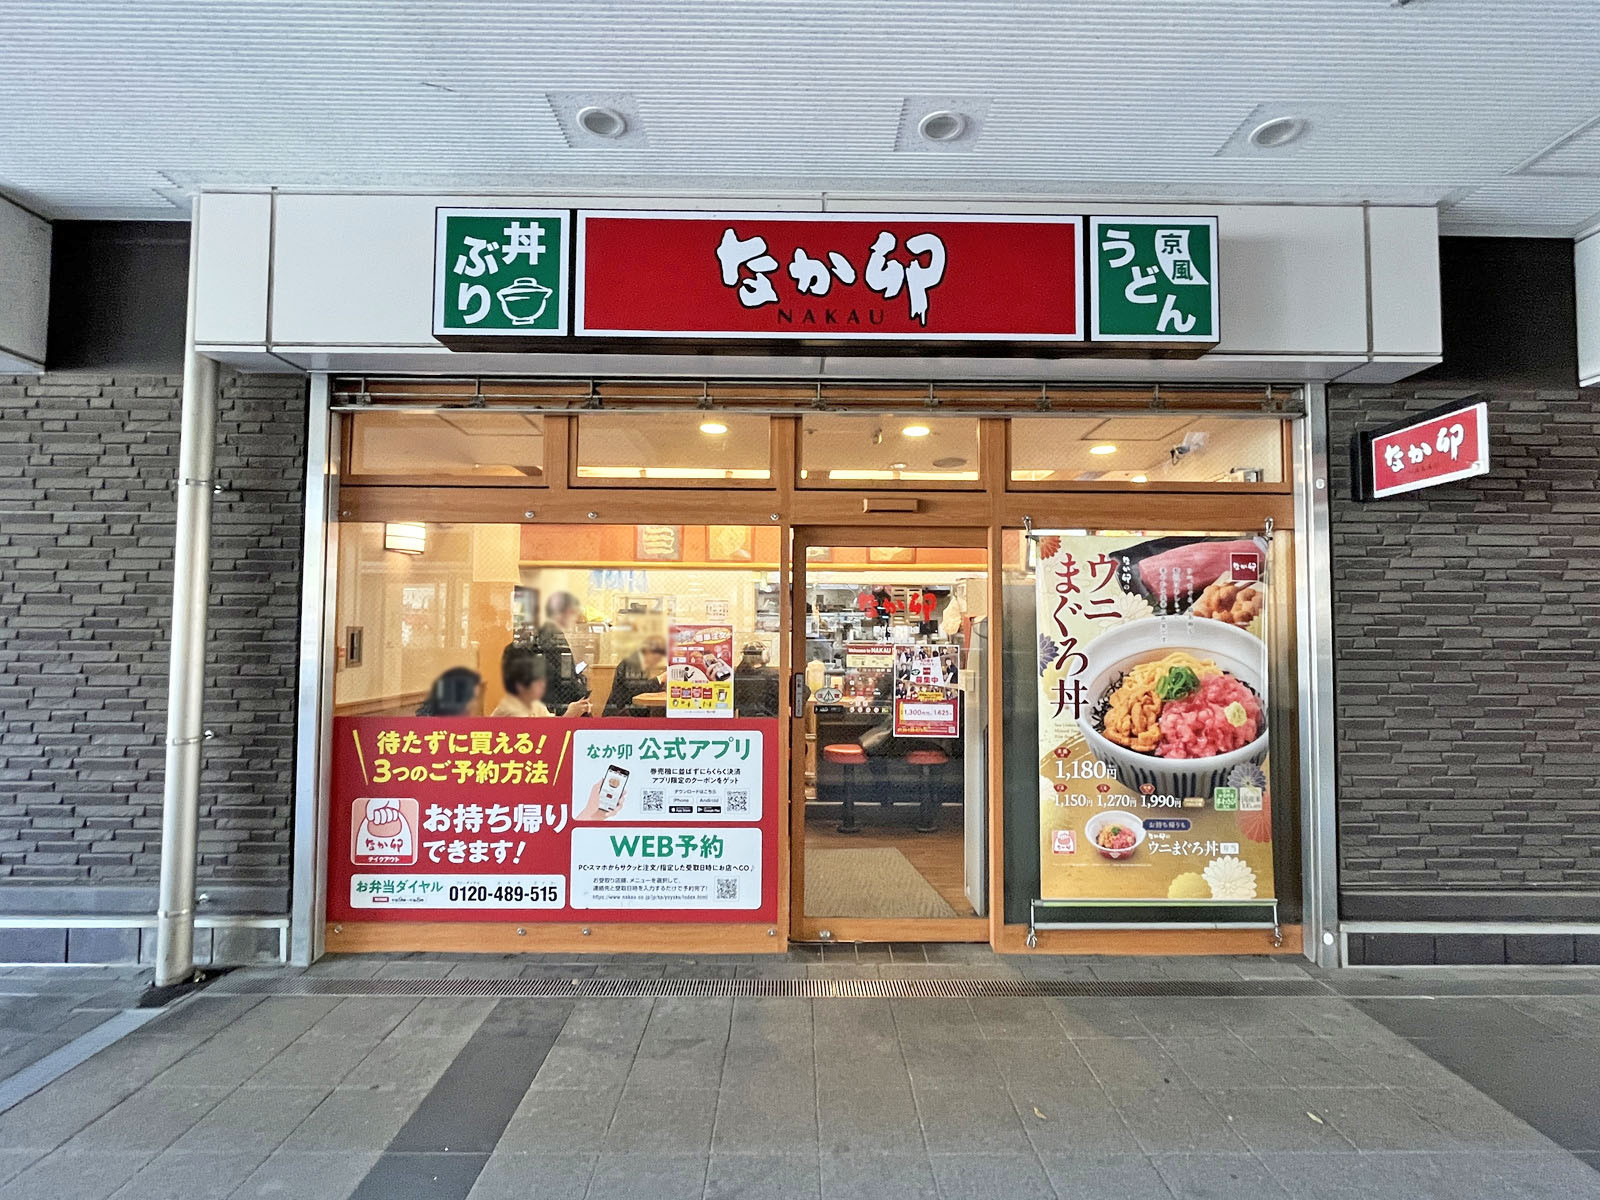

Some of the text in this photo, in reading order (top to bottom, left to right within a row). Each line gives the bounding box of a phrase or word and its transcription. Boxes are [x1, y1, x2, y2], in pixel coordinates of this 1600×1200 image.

[1161, 233, 1193, 281] 京風
[715, 227, 947, 326] なか卯
[1102, 229, 1196, 332] うどん
[778, 308, 885, 325] NAKAU
[1384, 423, 1464, 473] なか卯
[1084, 553, 1122, 620] ウニ
[857, 592, 937, 623] なか卯
[1050, 553, 1090, 720] まぐろ丼
[587, 737, 751, 761] なか卯 公式アプリ
[372, 758, 549, 784] 3つのご予約方法
[422, 803, 568, 834] お持ち帰り
[365, 838, 404, 853] なか卯
[609, 834, 724, 858] WEB予約
[1148, 840, 1219, 857] ウニまぐろ丼
[355, 880, 444, 894] お弁当ダイヤル
[449, 885, 558, 902] 0120-489-515
